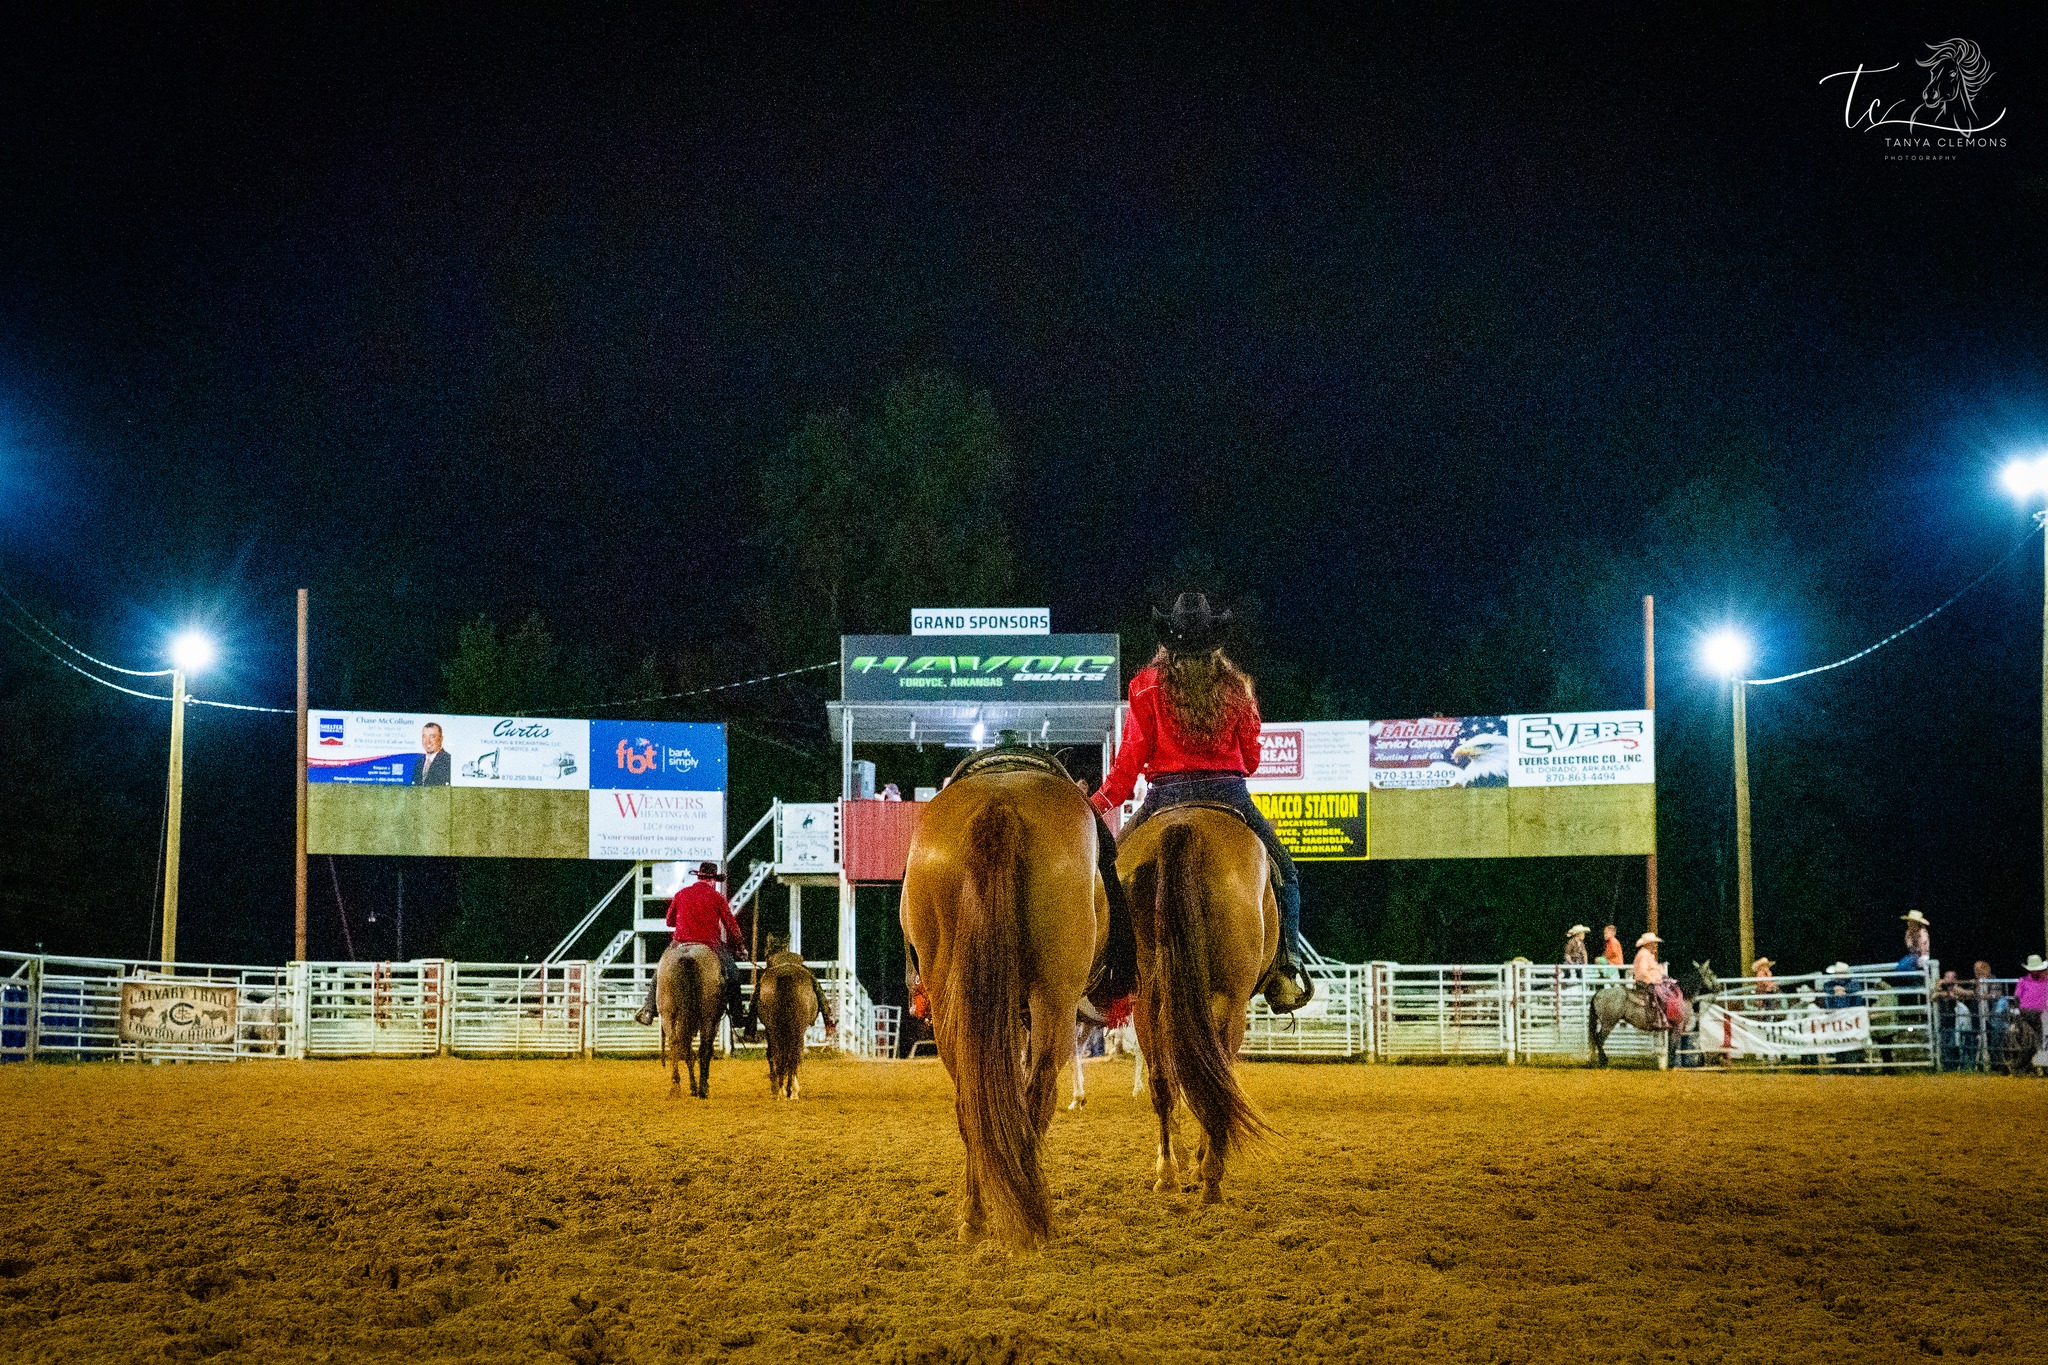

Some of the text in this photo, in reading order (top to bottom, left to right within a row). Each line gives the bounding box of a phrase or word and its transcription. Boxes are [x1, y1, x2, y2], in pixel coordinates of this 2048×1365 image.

[914, 614, 1048, 629] GRAND SPONSORS
[850, 656, 1116, 674] HAVOC
[1012, 672, 1106, 681] BOATS
[900, 677, 1003, 688] FORDYCE, ARKANSAS
[493, 719, 554, 738] Curtis
[1518, 717, 1643, 755] EVERS
[1257, 736, 1297, 749] FARM
[1374, 739, 1455, 750] Service Company
[616, 739, 691, 774] fbt bank
[1260, 748, 1298, 761] REAU
[1411, 752, 1430, 760] and
[669, 758, 699, 768] simply
[1519, 757, 1549, 766] EVERS
[1552, 755, 1599, 765] ELECTRIC
[1582, 764, 1631, 772] ARKANSAS
[1546, 773, 1616, 783] 870-863-4494
[613, 793, 704, 818] WEAVERS
[1253, 794, 1359, 818] OBACCO STATION
[640, 810, 682, 819] HEATING
[691, 811, 707, 819] AIR
[1278, 819, 1328, 827] LOCATIONS:
[623, 833, 655, 841] comfort
[1274, 828, 1344, 836] DYCE, CAMDEN,
[1302, 836, 1354, 845] MAGNOLIA,
[1289, 845, 1344, 853] TEXARKANA
[129, 987, 229, 1008] CALVARY TRAIL
[1810, 1017, 1861, 1034] Trust
[128, 1022, 228, 1041] COWBOY CHURCH
